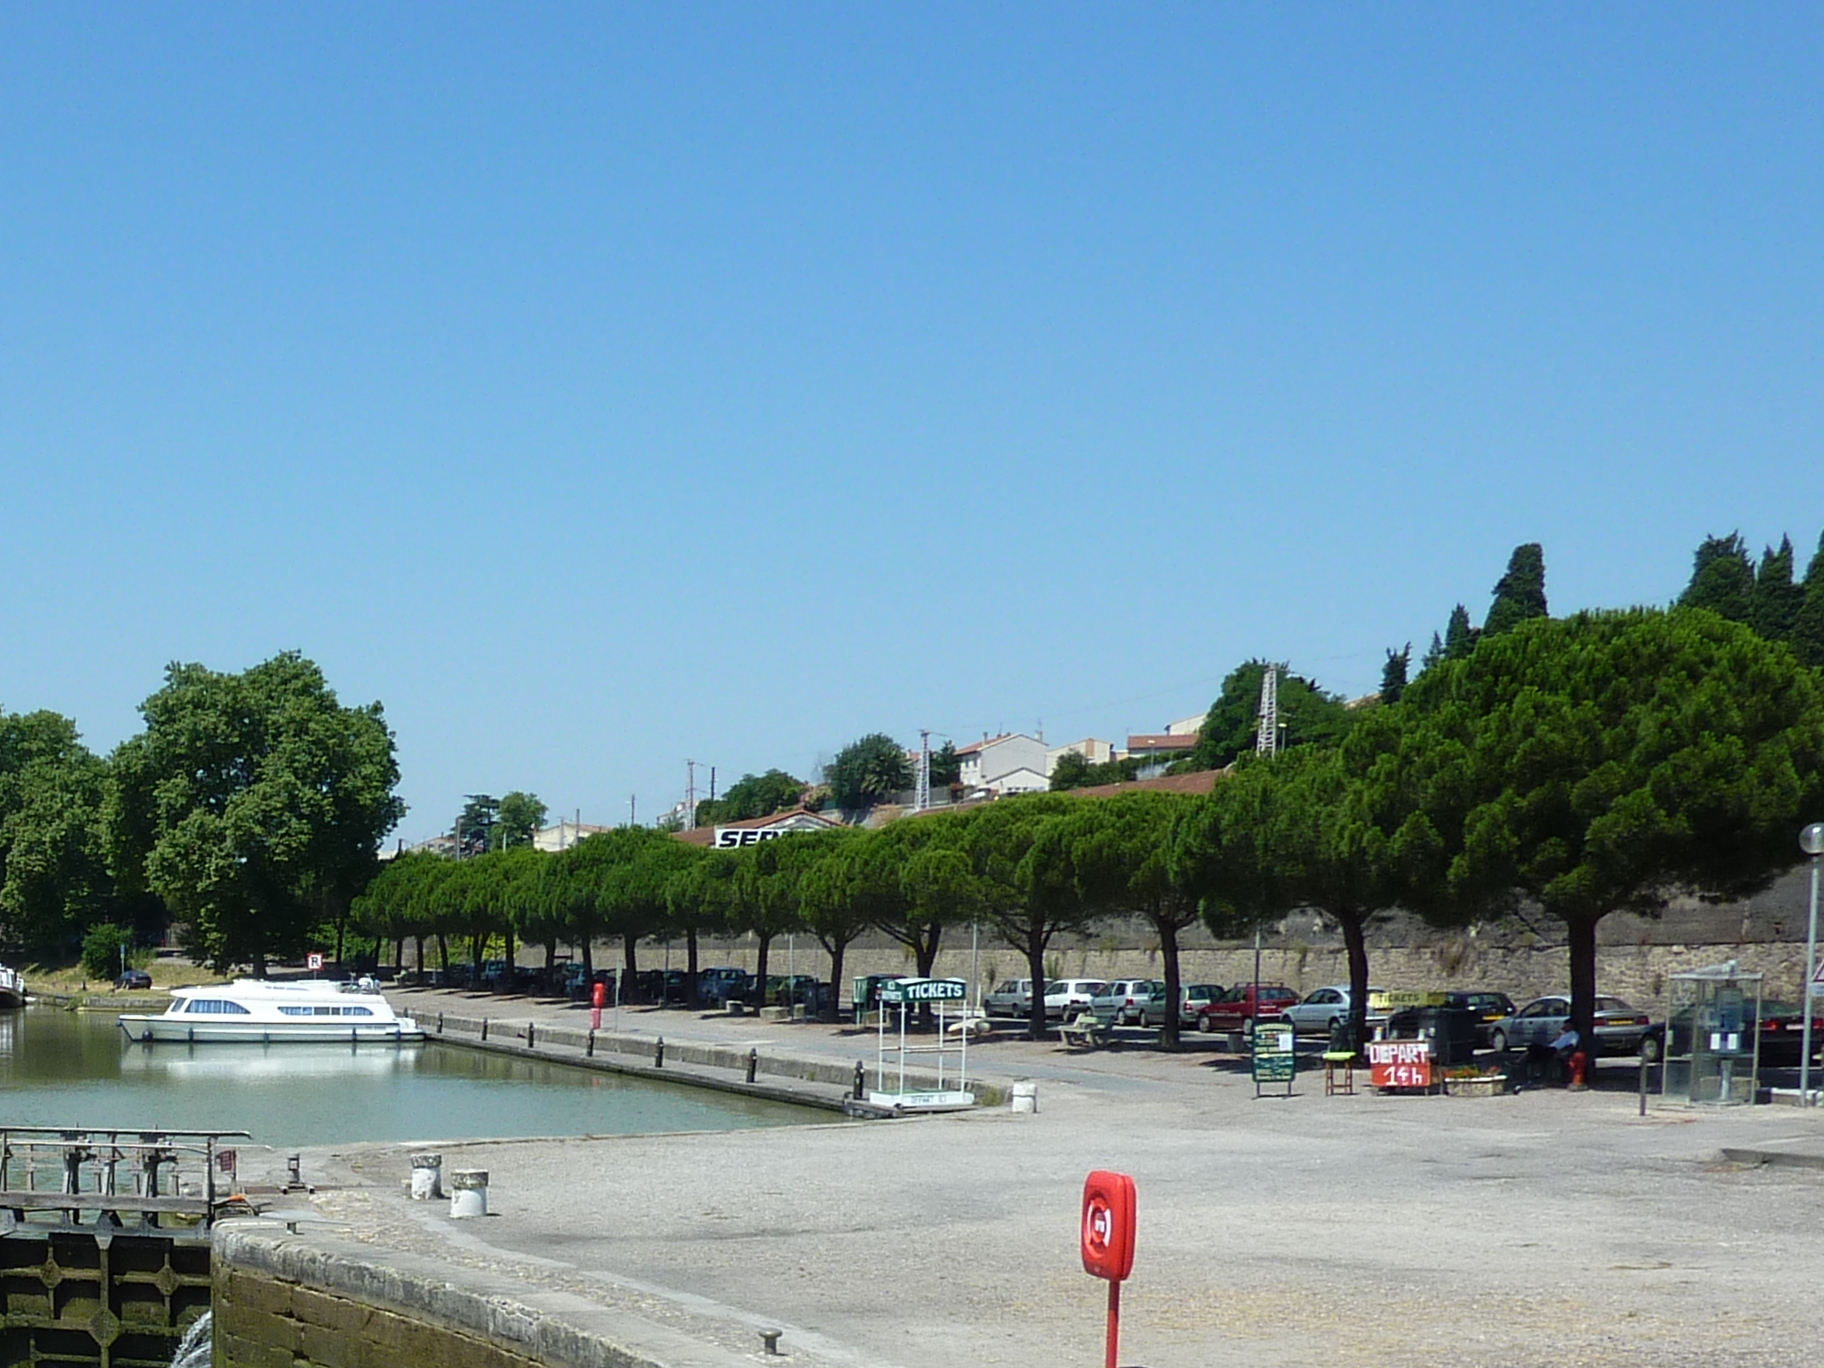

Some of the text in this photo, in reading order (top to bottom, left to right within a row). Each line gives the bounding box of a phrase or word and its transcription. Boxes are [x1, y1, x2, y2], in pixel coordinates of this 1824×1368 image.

[310, 956, 320, 967] R
[906, 983, 963, 999] TICKETS
[1378, 993, 1421, 1003] TICKETS
[1370, 1043, 1429, 1064] DEPART
